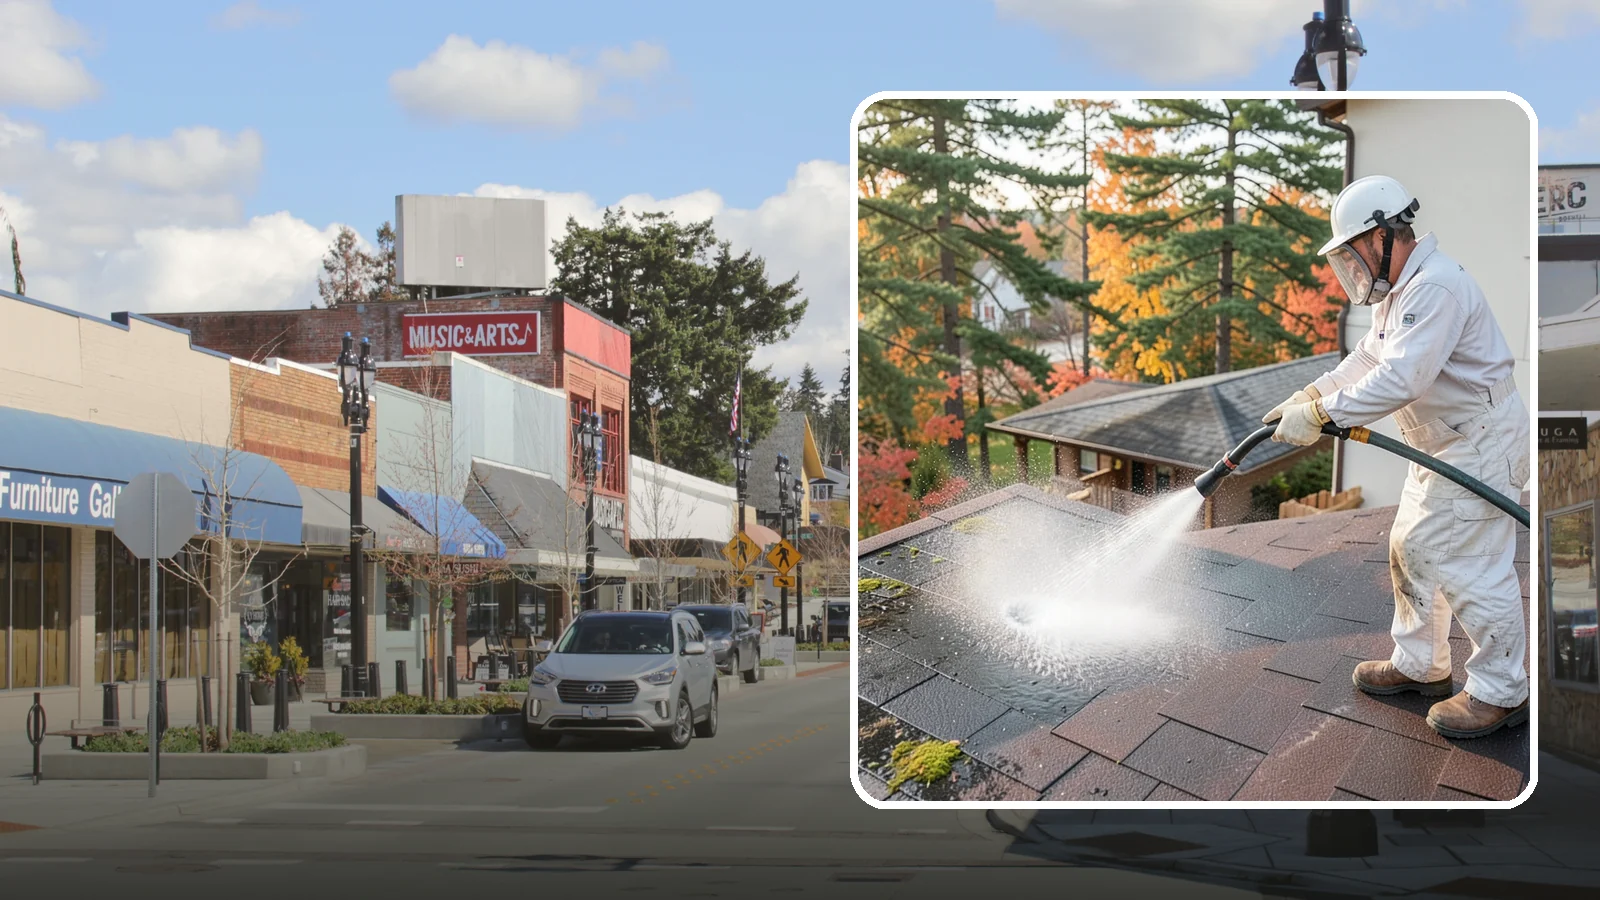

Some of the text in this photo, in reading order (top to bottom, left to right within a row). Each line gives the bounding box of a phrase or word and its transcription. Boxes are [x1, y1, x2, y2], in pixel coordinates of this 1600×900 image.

[409, 323, 519, 349] MUSIC&ARTS
[0, 471, 121, 519] Furniture Gal
